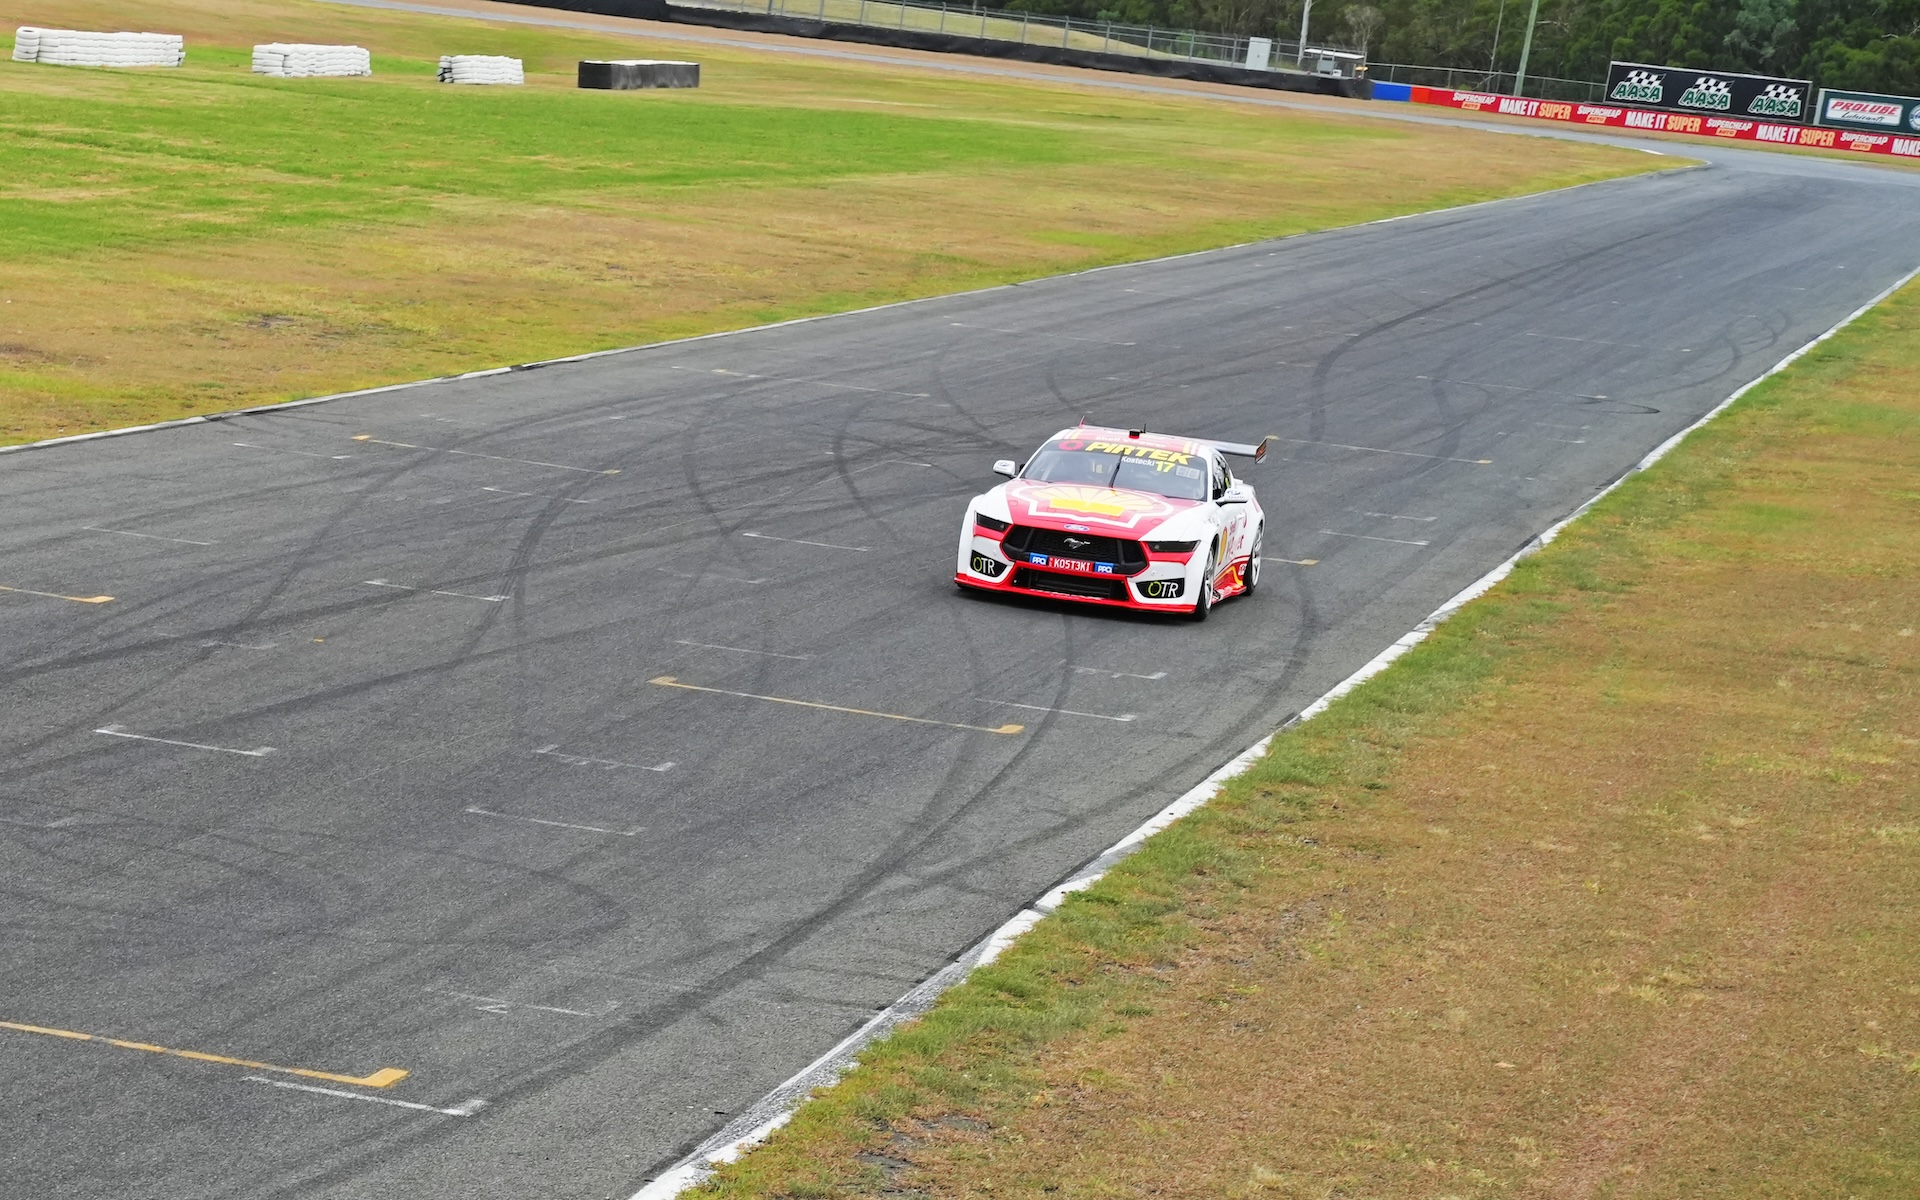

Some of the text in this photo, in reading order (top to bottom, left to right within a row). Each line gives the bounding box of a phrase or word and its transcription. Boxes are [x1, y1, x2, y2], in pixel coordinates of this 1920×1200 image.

[1453, 92, 1496, 105] SUPERCHEAP
[1611, 82, 1663, 102] AASA
[1679, 89, 1731, 110] AASA
[1498, 98, 1572, 120] MAKE IT SUPER
[1577, 105, 1622, 118] SUPERCHEAP
[1748, 96, 1801, 116] AASA
[1831, 101, 1899, 115] PROLUBE
[1624, 111, 1702, 132] MAKE IT SUPER
[1706, 118, 1753, 131] SUPERCHEAP
[1841, 111, 1885, 123] Lubricants
[1756, 124, 1836, 146] MAKE IT SUPER
[1840, 132, 1889, 145] SUPERCHEAP
[1085, 441, 1195, 465] PIRTEK
[1120, 455, 1156, 466] Kostecki
[1155, 461, 1176, 473] 17
[973, 556, 995, 575] OTR
[1032, 556, 1047, 565] PPQ
[1147, 581, 1179, 598] OTR
